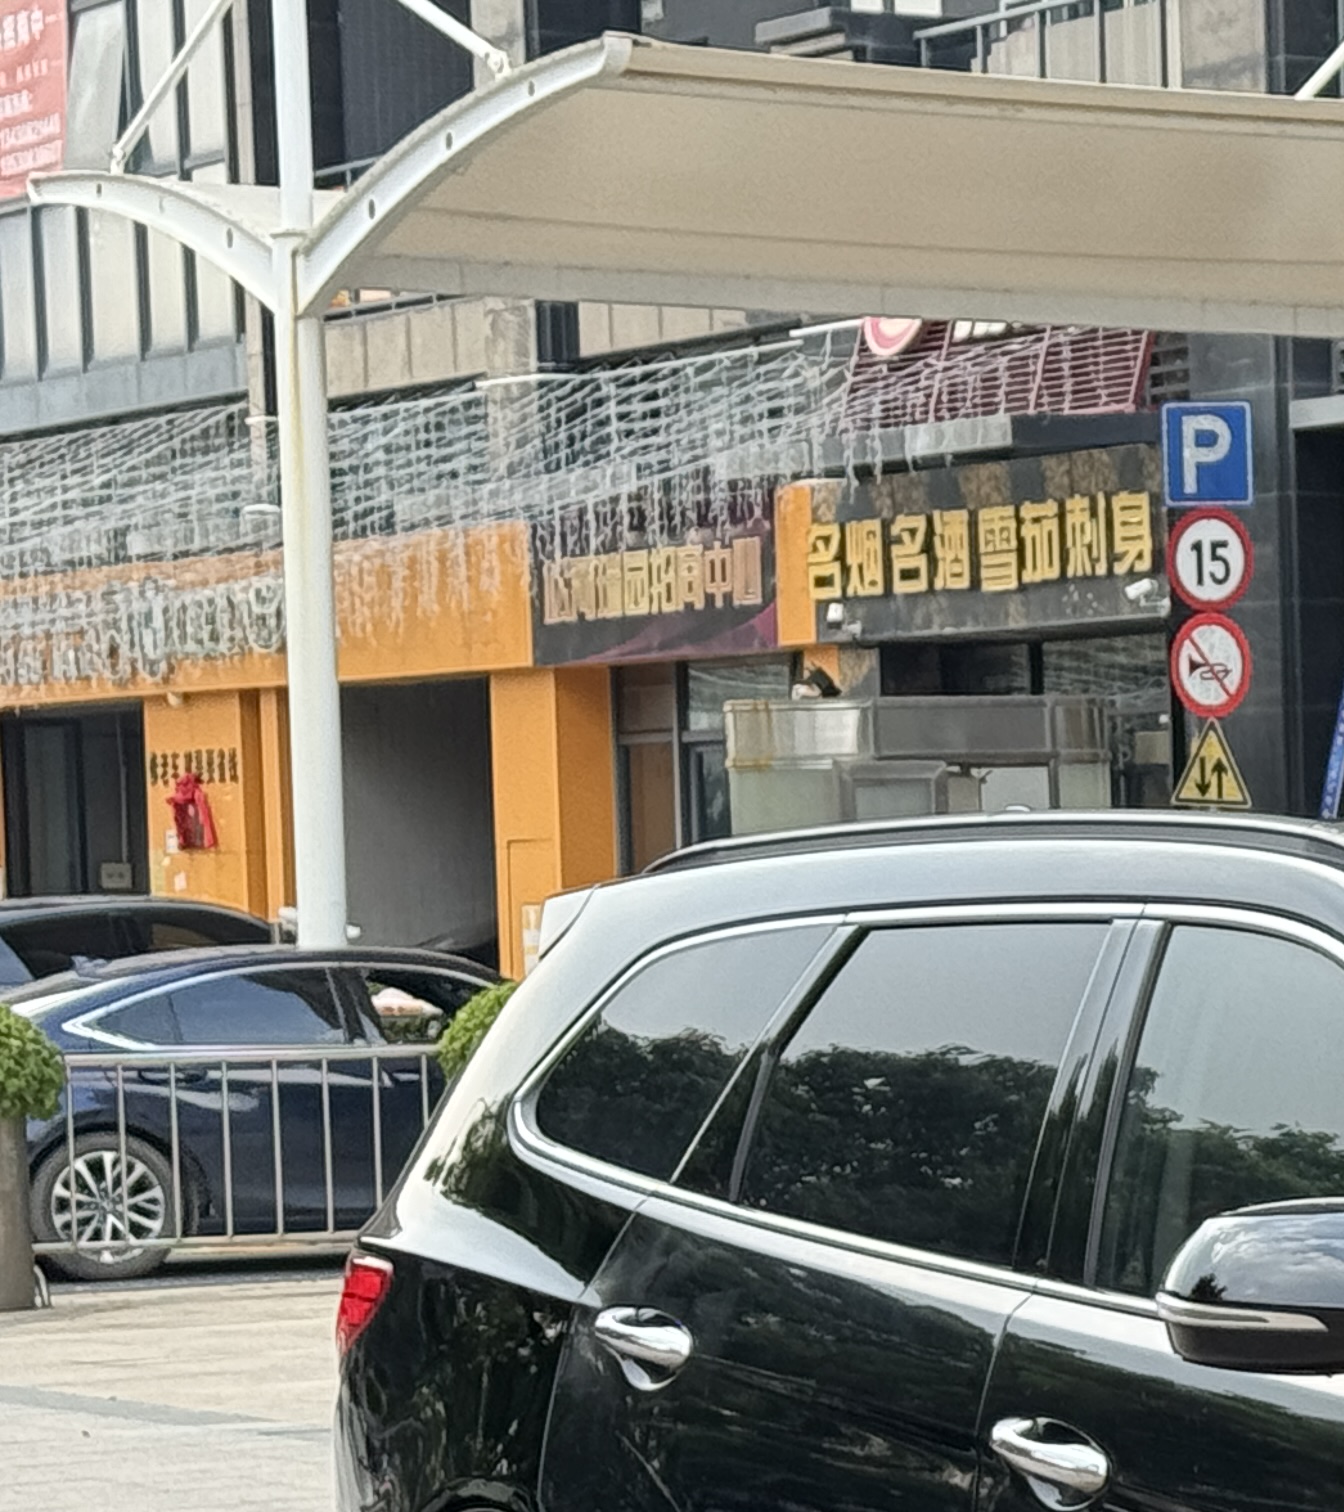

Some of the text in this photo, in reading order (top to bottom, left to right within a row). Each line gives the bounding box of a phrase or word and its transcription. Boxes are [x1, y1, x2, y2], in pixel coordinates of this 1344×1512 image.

[1181, 413, 1233, 495] P
[806, 490, 1153, 600] 名烟名酒雪茄刺身
[1190, 539, 1231, 587] 15
